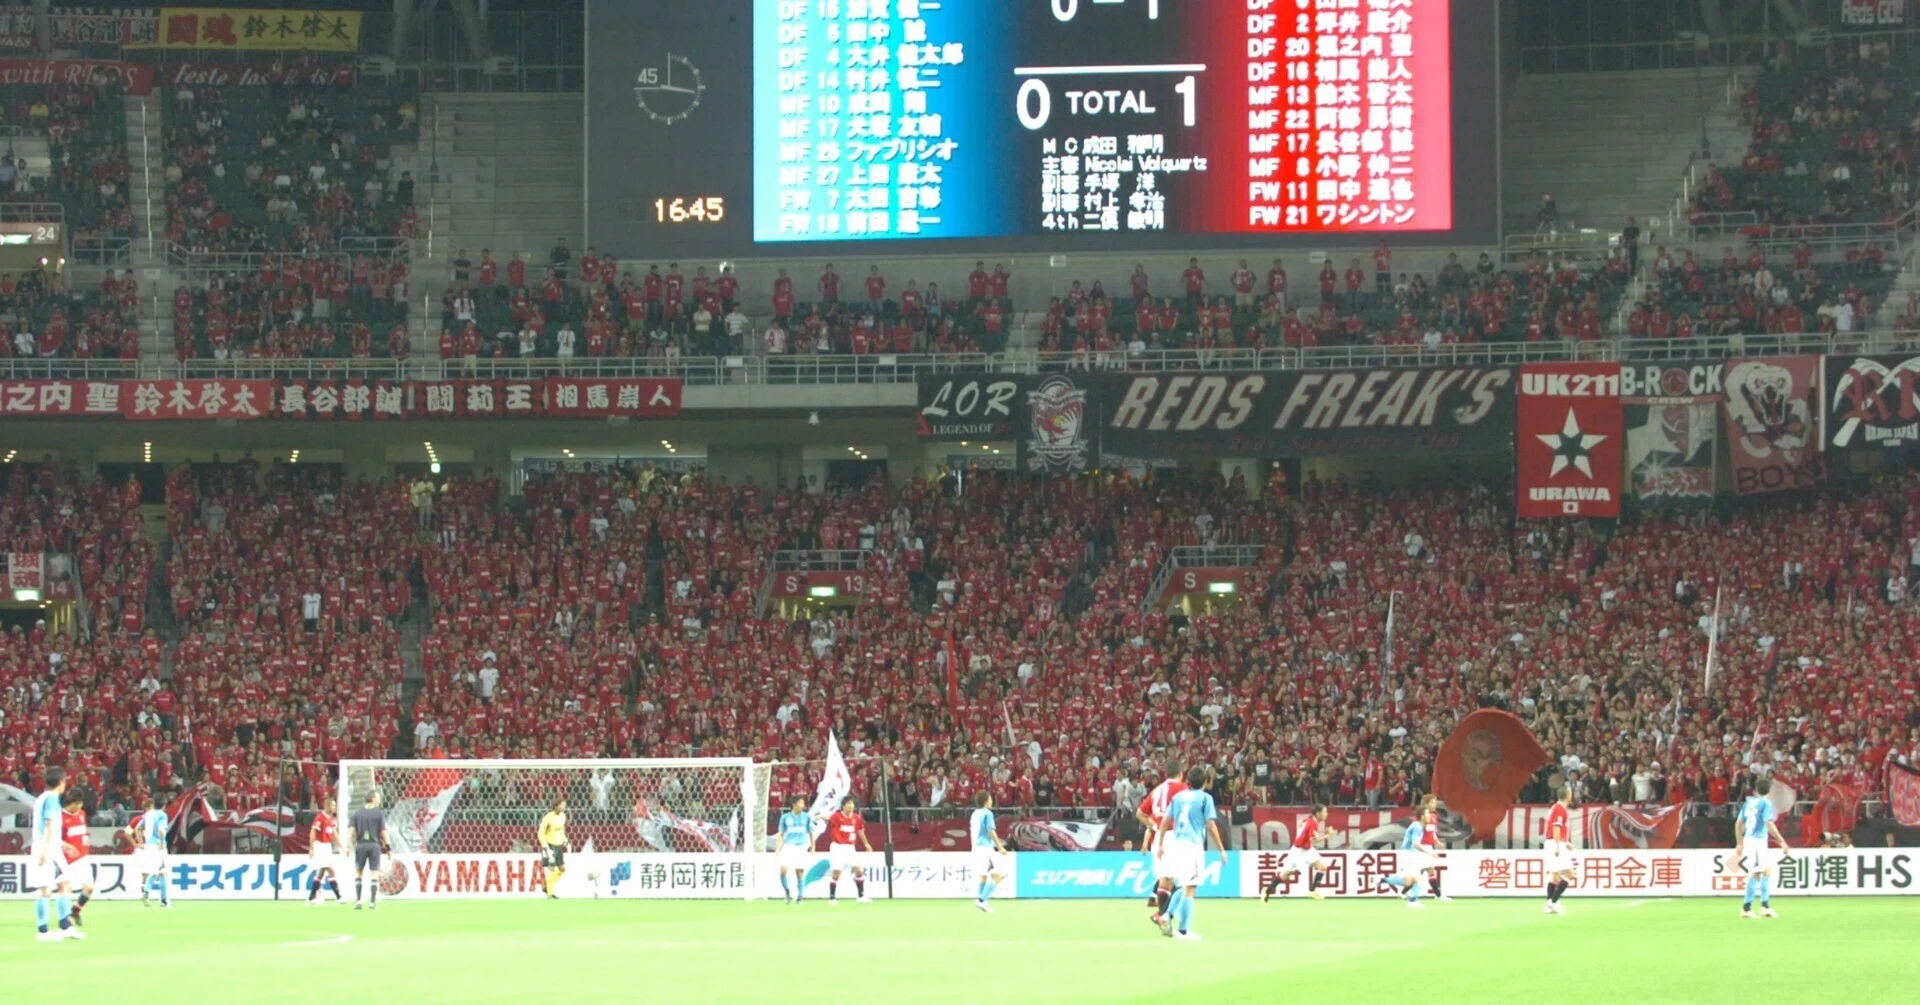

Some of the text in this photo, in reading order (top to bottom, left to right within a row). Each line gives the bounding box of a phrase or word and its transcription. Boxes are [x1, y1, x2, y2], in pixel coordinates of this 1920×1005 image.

[779, 24, 808, 43] DF
[1247, 14, 1276, 34] DF
[1297, 13, 1309, 33] 2
[779, 48, 808, 67] DF
[827, 48, 840, 67] 4
[1247, 37, 1277, 58] DF
[1285, 37, 1310, 57] 20
[637, 68, 658, 84] 45
[779, 71, 808, 91] DF
[817, 71, 840, 91] 14
[1248, 62, 1277, 81] DF
[1286, 61, 1309, 80] 16
[1016, 75, 1195, 130] 0 TOTAL 1
[1248, 85, 1279, 105] MF
[1287, 85, 1309, 104] 13
[817, 118, 840, 138] 17
[1248, 110, 1279, 129] MF
[1285, 109, 1309, 129] 22
[846, 138, 958, 162] ファブリシオ
[1249, 133, 1280, 153] MF
[1287, 133, 1309, 152] 17
[1085, 155, 1133, 172] Nicolai
[1137, 154, 1208, 175] Volquartz
[1249, 157, 1280, 177] MF
[1297, 157, 1310, 176] 8
[780, 189, 811, 209] FW
[827, 189, 840, 209] 7
[1249, 181, 1280, 201] FW
[1287, 181, 1307, 200] 11
[780, 212, 811, 233] FW
[1042, 213, 1079, 230] 4th
[1249, 202, 1415, 225] FW 21 ワシントン
[36, 226, 56, 241] 24
[1522, 373, 1620, 397] UK211
[0, 381, 119, 412] 之内 聖
[134, 382, 260, 415] 鈴木啓太
[280, 384, 403, 416] 長谷部誠
[921, 380, 1018, 418] LOR
[1111, 368, 1511, 431] REDS FREAK'S
[932, 425, 977, 435] LEGEND
[978, 423, 994, 434] OF
[1529, 486, 1611, 502] URAWA
[48, 581, 68, 596] 14
[785, 576, 864, 593] S 13
[1183, 571, 1197, 589] S
[413, 860, 547, 892] YAMAHA
[1777, 855, 1849, 889] 創輝
